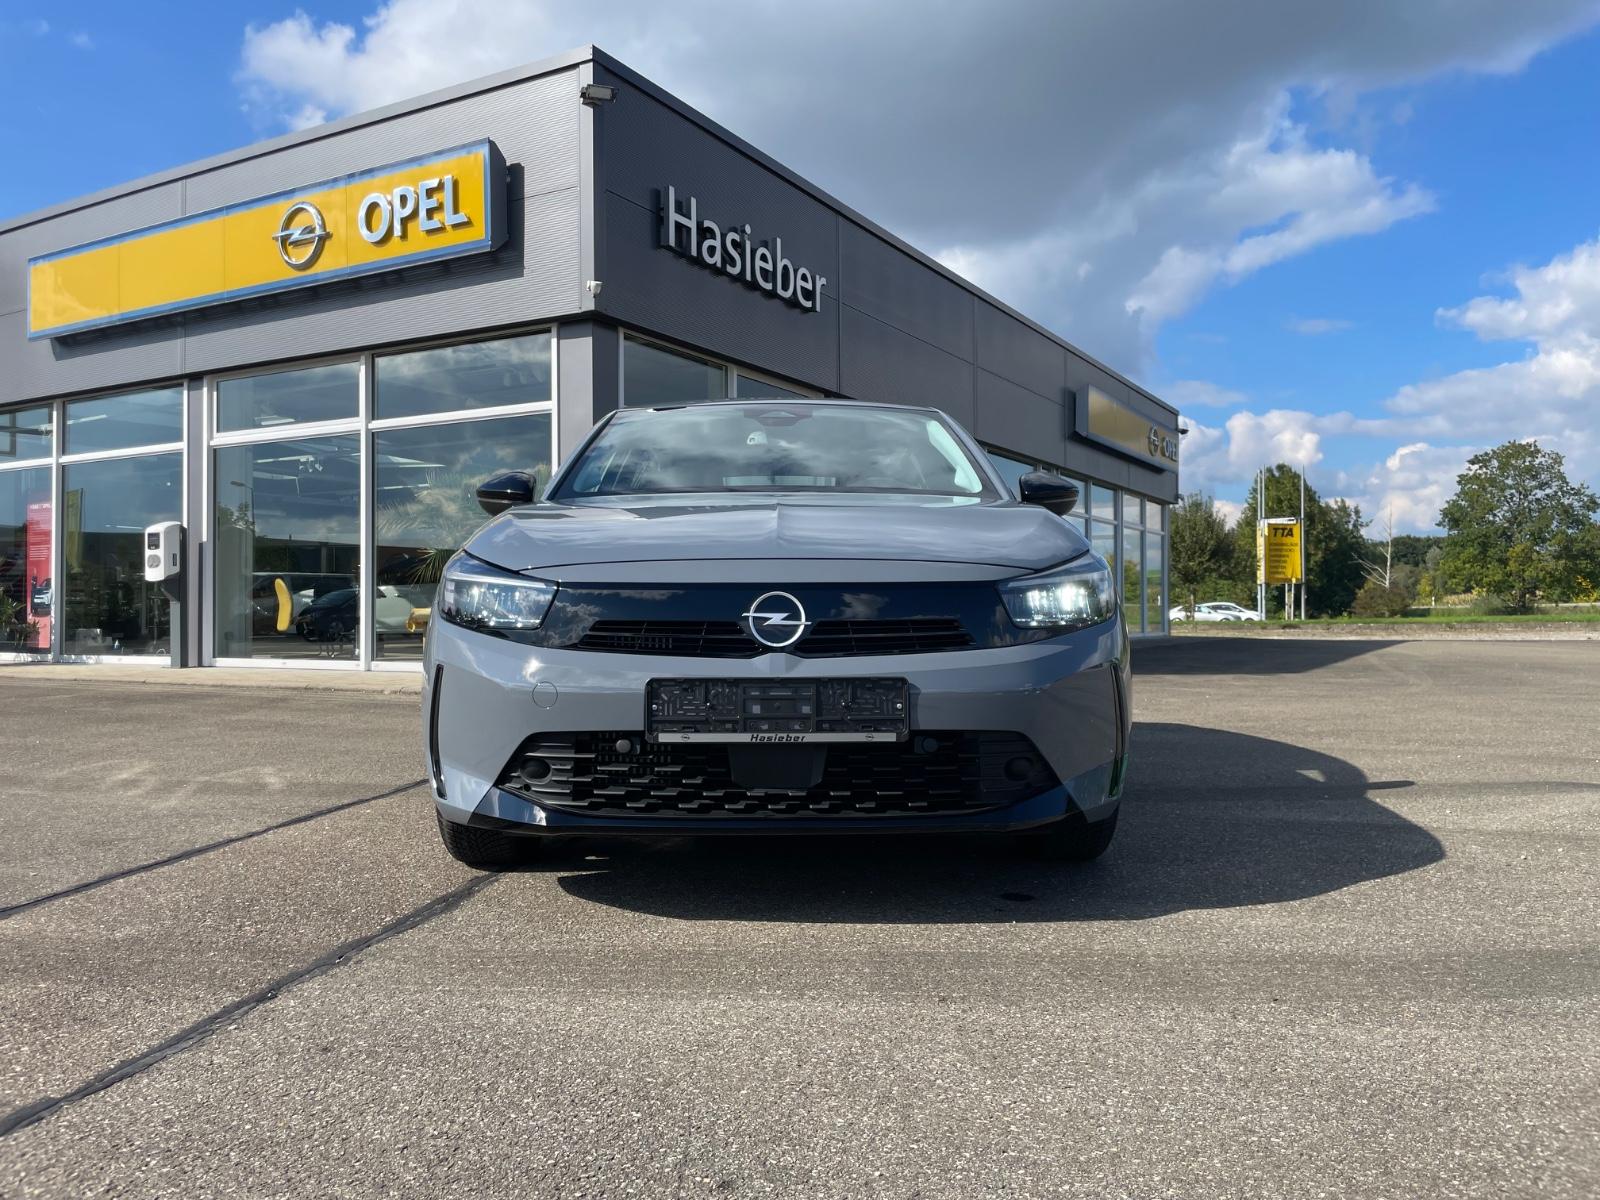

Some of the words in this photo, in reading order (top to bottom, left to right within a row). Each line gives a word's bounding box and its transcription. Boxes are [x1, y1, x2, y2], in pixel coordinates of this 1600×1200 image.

[358, 174, 468, 243] OPEL
[668, 184, 827, 313] Hasieber
[1272, 527, 1294, 537] TTA
[750, 733, 806, 742] Hasieber
